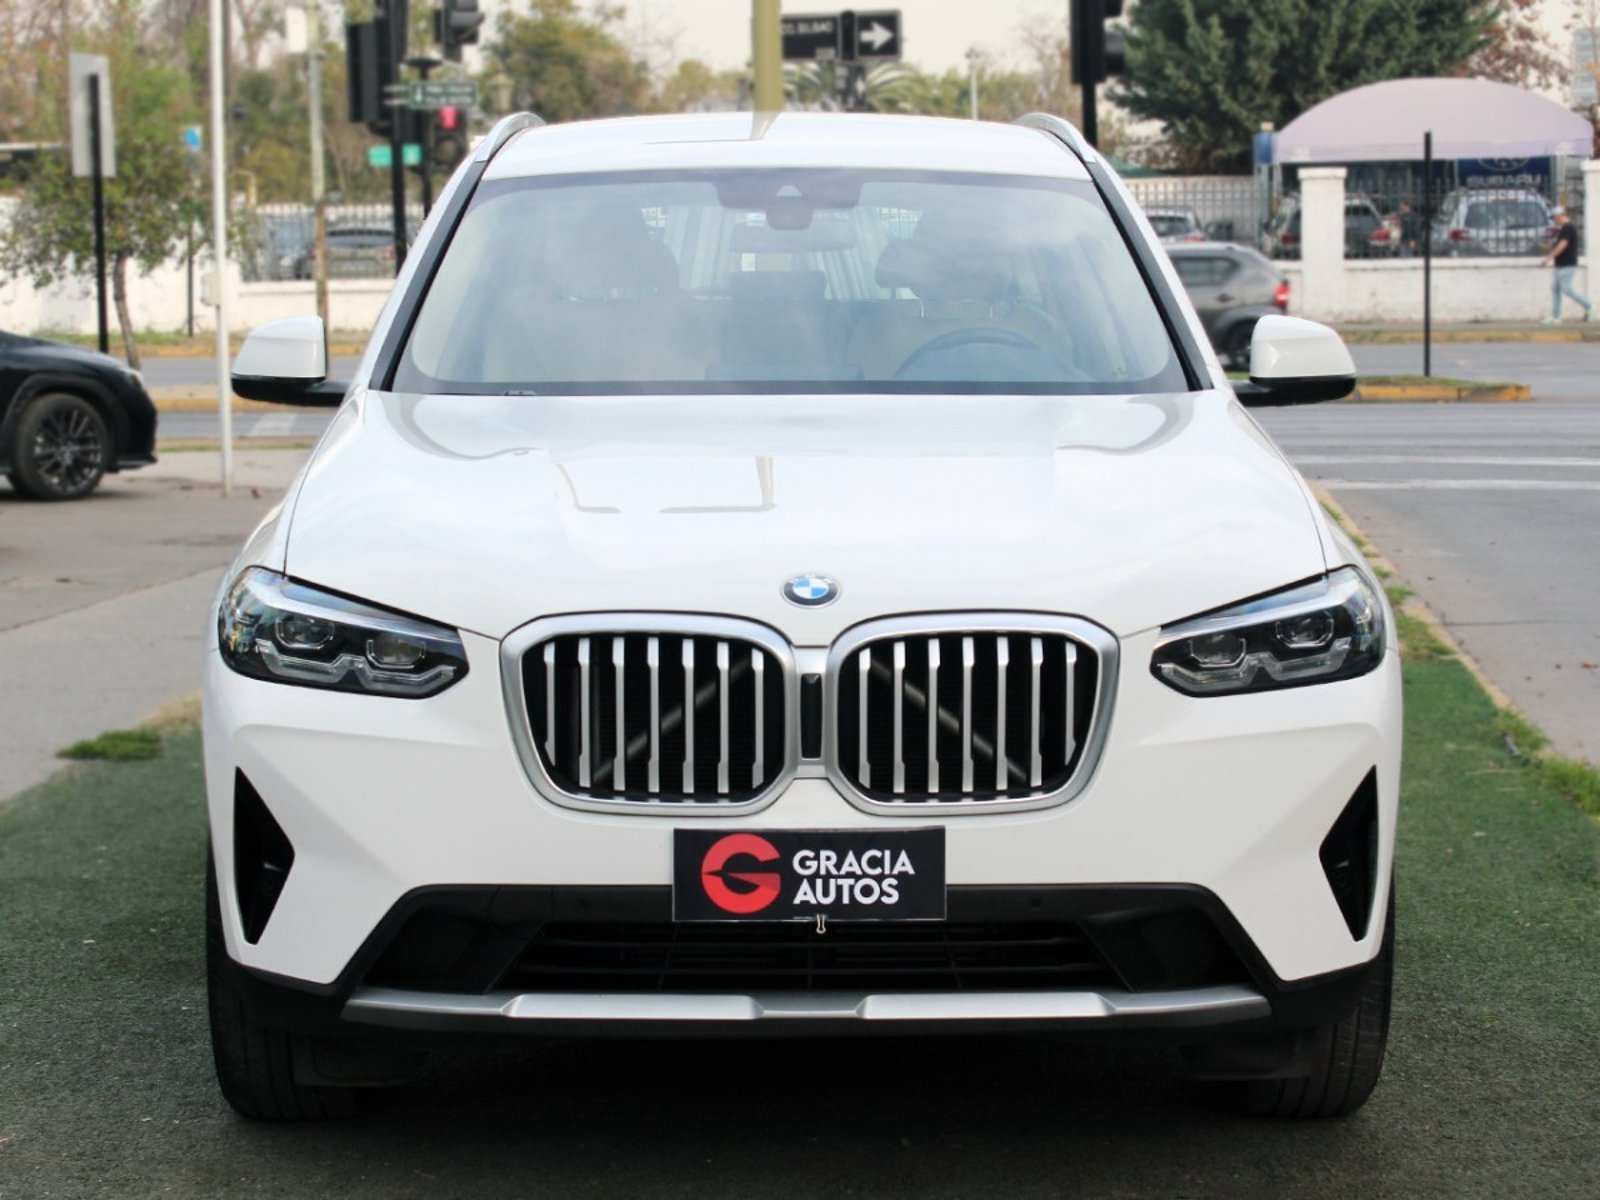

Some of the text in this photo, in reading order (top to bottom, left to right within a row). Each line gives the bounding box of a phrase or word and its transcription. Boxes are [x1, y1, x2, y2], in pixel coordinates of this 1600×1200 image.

[1466, 174, 1541, 188] SUBARU
[792, 849, 915, 876] GRACIA
[792, 878, 900, 905] AUTOS
